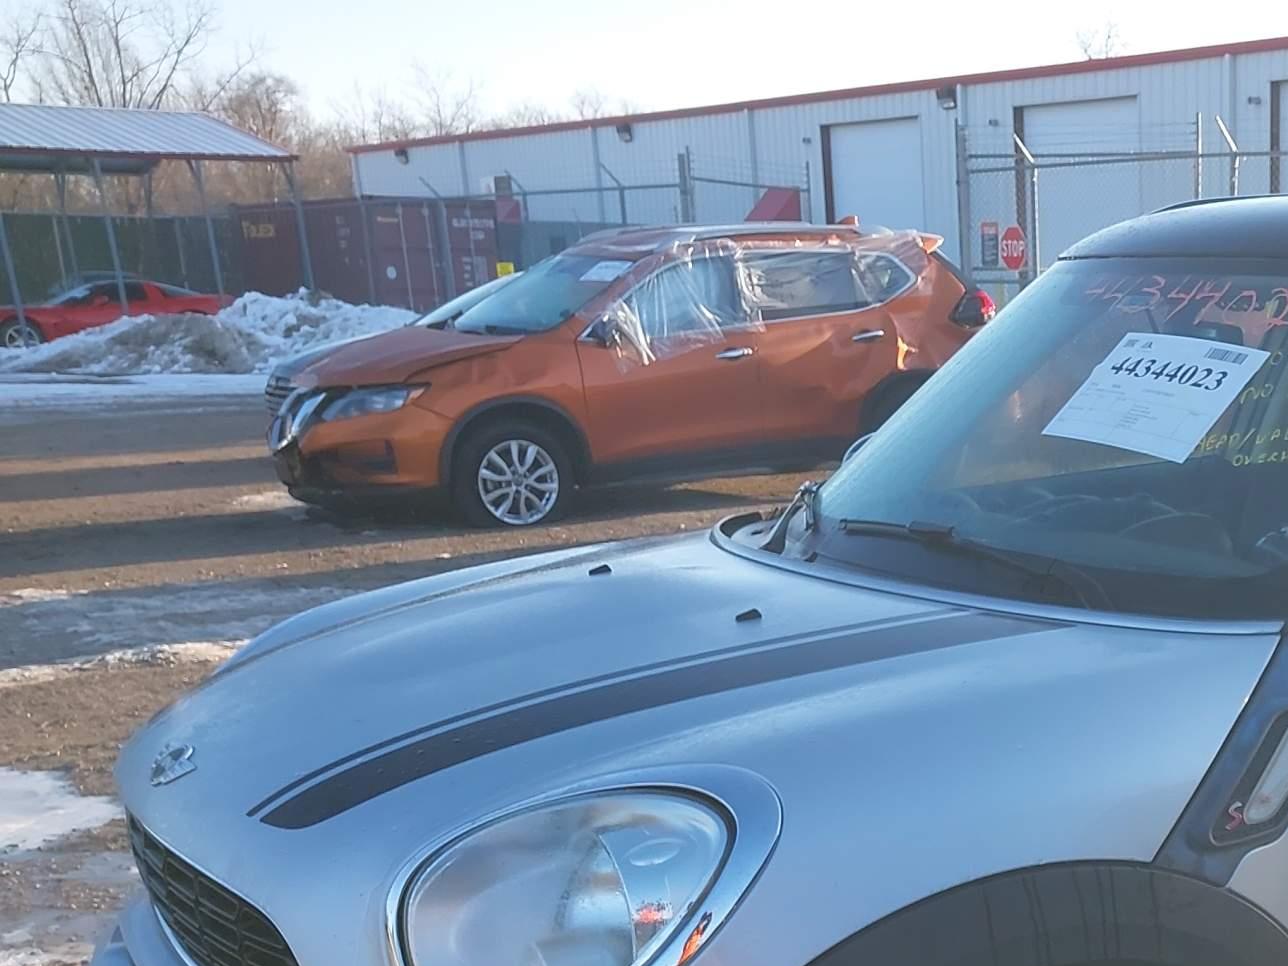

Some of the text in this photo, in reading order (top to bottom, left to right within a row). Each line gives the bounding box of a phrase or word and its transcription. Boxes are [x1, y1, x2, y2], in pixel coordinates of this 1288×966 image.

[1002, 239, 1025, 257] STOP
[1111, 356, 1229, 392] 44344023
[1239, 384, 1273, 405] NO
[1225, 800, 1244, 832] S
